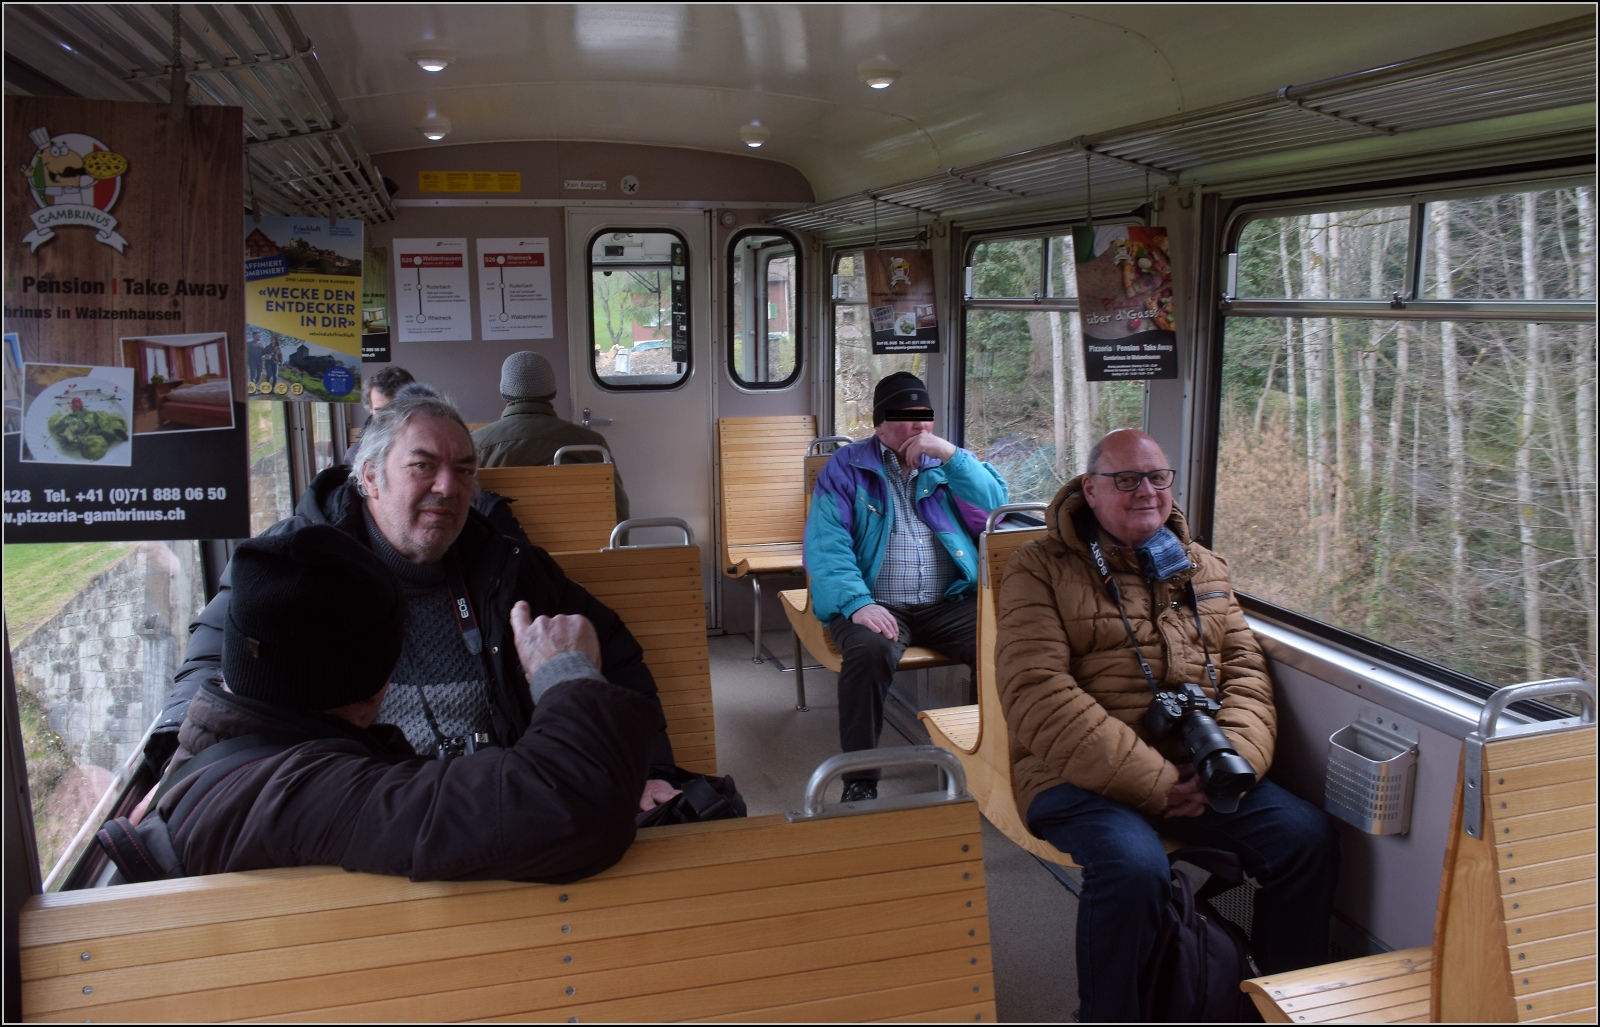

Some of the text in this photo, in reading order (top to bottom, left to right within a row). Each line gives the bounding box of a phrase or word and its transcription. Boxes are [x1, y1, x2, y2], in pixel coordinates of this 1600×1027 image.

[580, 181, 604, 189] Ausgang
[37, 208, 111, 228] GAMBRINUS
[293, 225, 321, 233] Frischluft
[484, 256, 496, 264] S26
[22, 276, 229, 301] Pension Take Away
[258, 286, 355, 302] «WECKE DEN
[4, 306, 182, 321] brinus in Walzenhausen
[265, 300, 355, 315] ENTDECKER
[300, 315, 356, 329] IN DIR»
[1086, 311, 1111, 325] über
[1088, 343, 1174, 353] Pizzeria Pension Take Away
[43, 489, 71, 503] Tel.
[75, 488, 104, 503] +41
[108, 487, 148, 505] (0)71
[152, 487, 182, 501] 888
[184, 486, 205, 501] 06
[207, 486, 227, 501] 50
[1089, 541, 1108, 576] SONY
[456, 597, 470, 619] EOS
